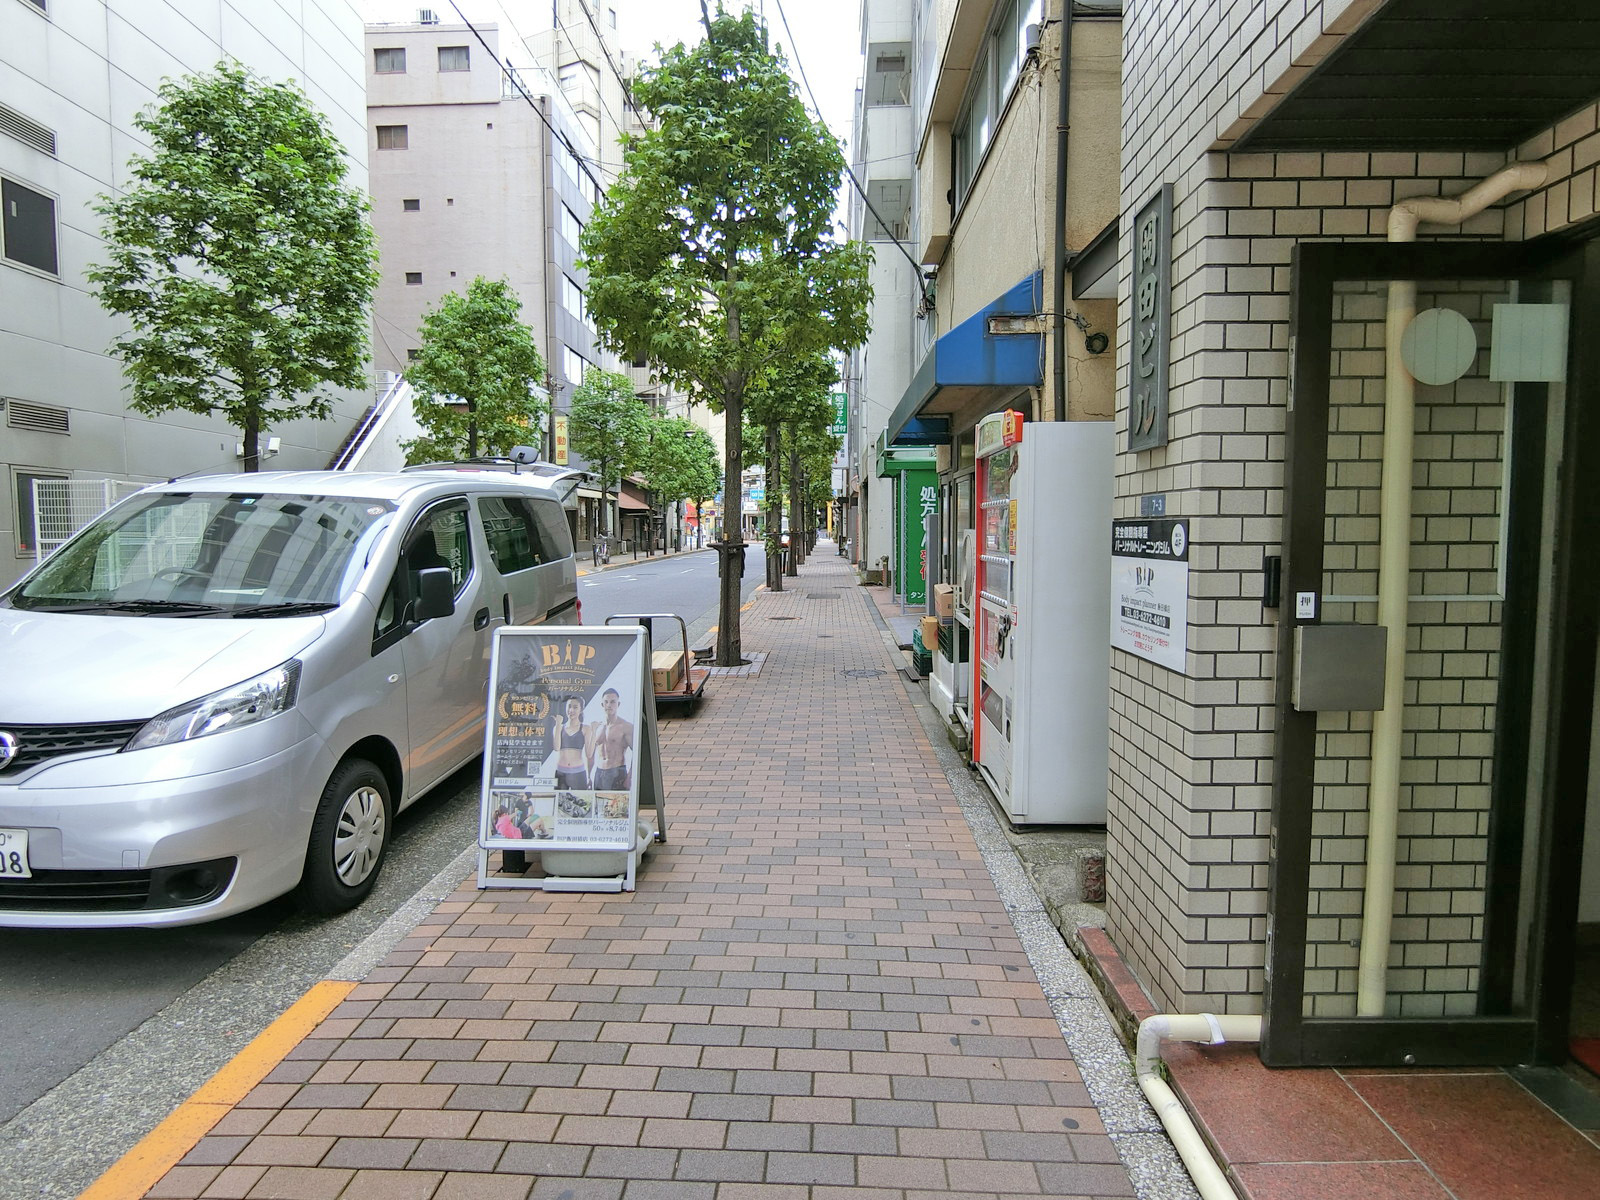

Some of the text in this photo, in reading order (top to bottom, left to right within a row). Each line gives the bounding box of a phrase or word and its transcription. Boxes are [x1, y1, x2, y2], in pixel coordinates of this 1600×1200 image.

[556, 421, 567, 460] 不動産
[1300, 596, 1311, 606] 押
[511, 702, 538, 716] 無料
[498, 726, 545, 737] 理想の体型
